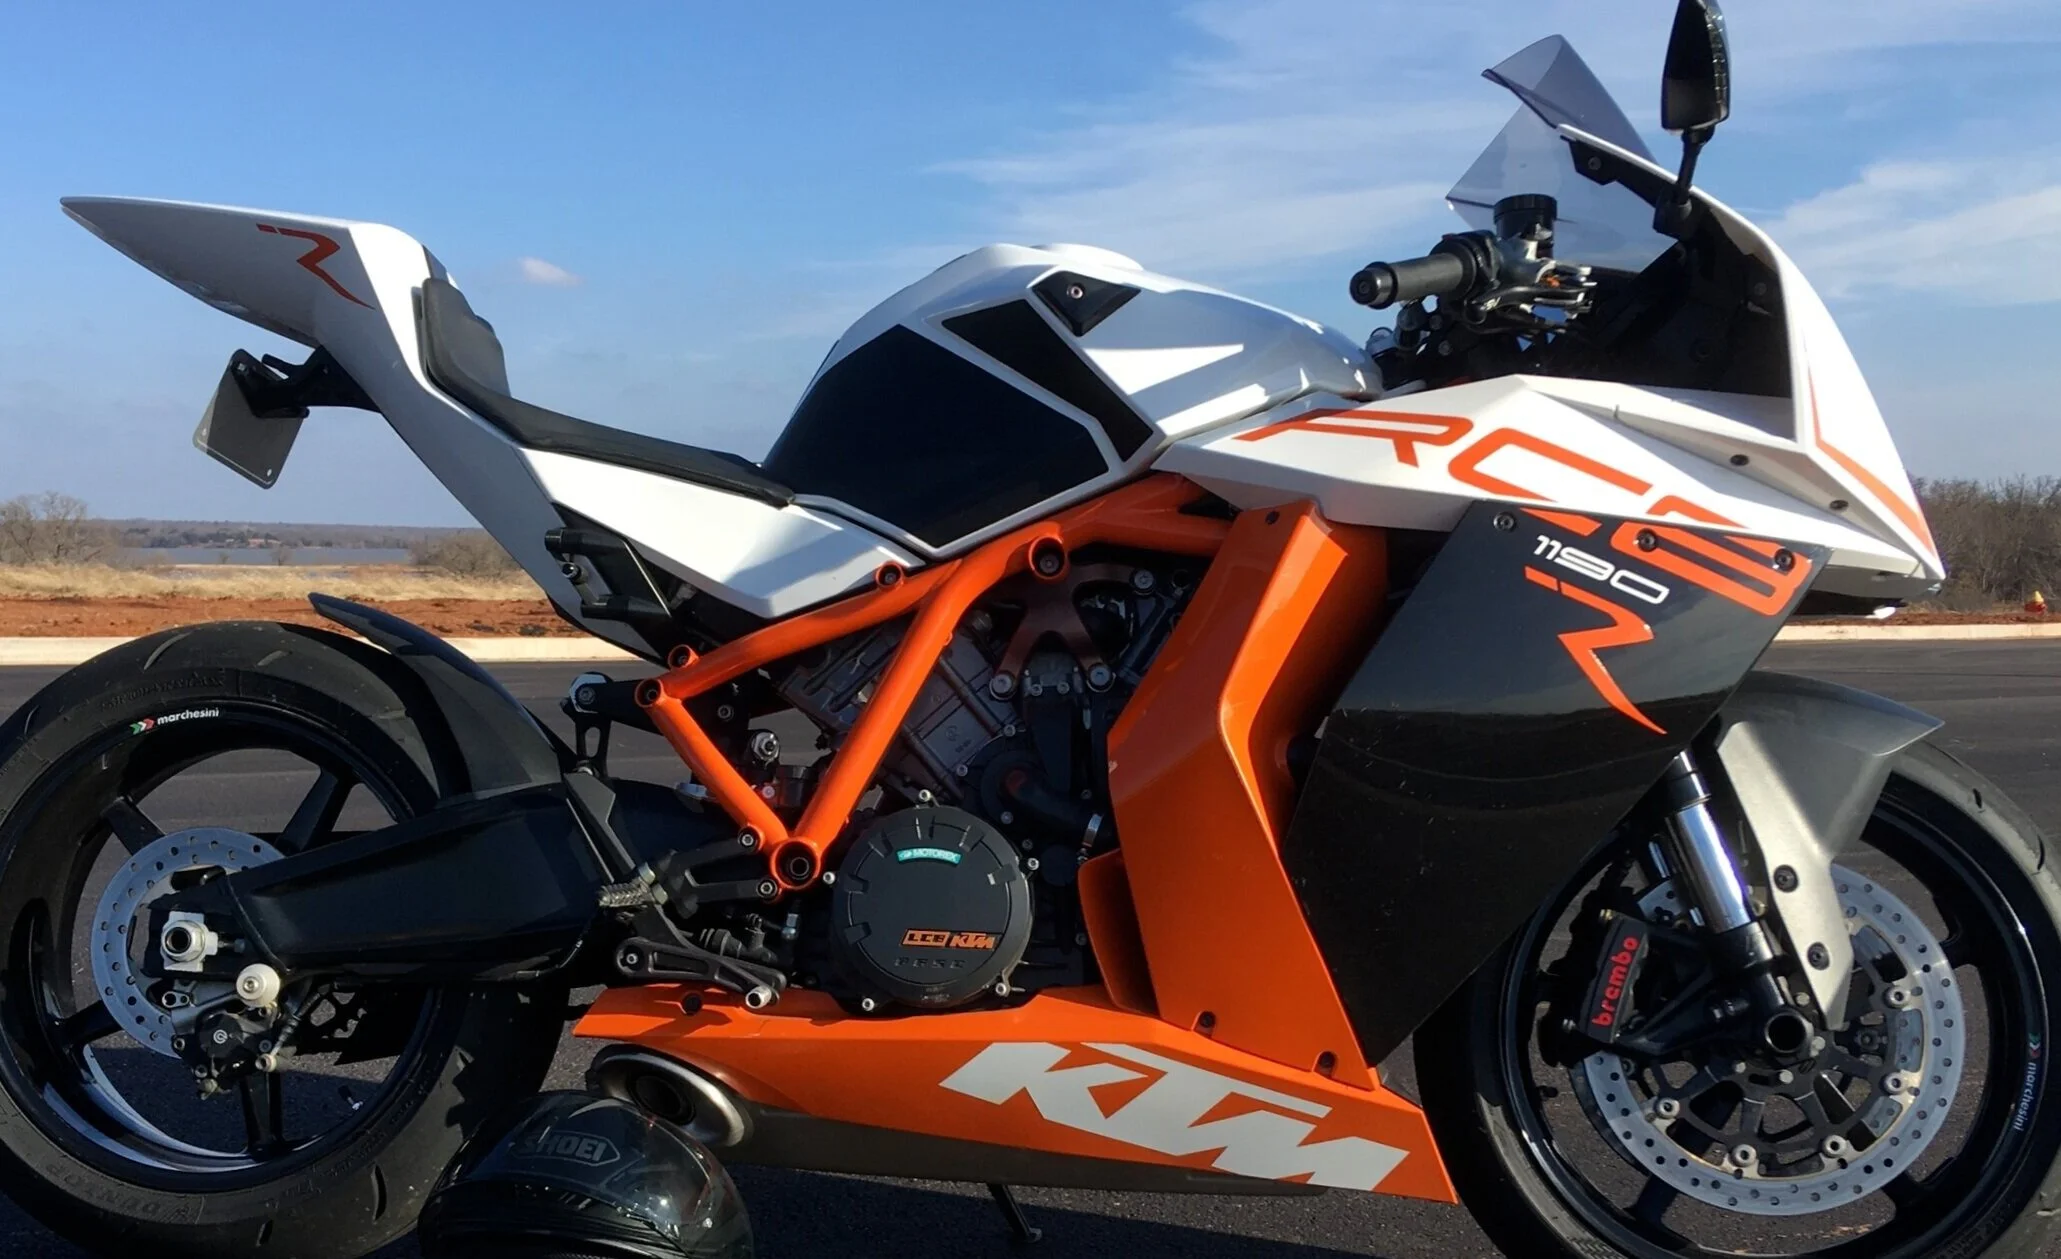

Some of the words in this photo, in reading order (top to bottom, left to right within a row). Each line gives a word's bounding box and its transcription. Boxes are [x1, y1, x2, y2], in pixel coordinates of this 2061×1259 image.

[1533, 535, 1670, 604] 1190
[157, 708, 220, 726] marchesini
[912, 847, 960, 863] MOTOREX
[949, 931, 995, 949] KTM
[1591, 936, 1639, 1026] brembo
[938, 1042, 1410, 1190] KTM
[2012, 1061, 2037, 1132] marchesini
[516, 1135, 608, 1161] SHOEI
